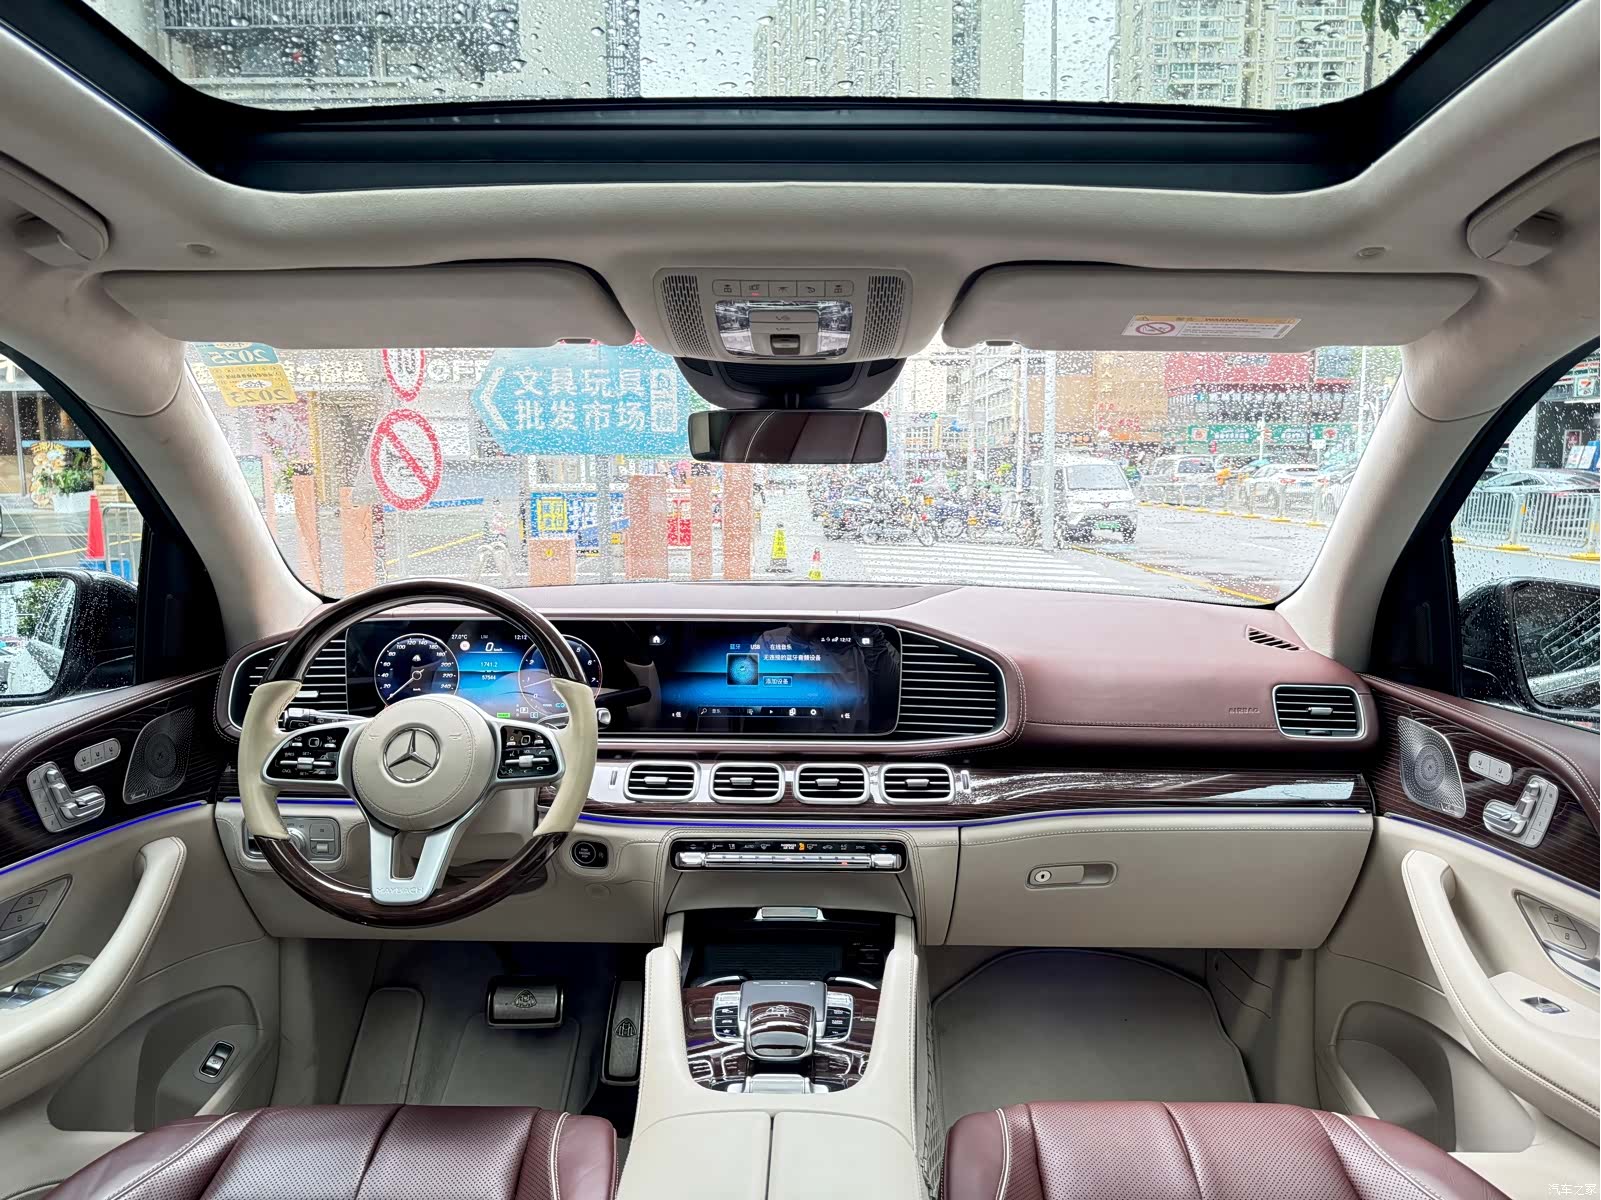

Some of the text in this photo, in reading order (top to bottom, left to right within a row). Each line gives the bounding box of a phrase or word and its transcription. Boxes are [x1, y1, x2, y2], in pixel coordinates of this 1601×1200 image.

[513, 366, 645, 397] 文具玩具
[514, 400, 646, 432] 批发市场
[485, 641, 494, 652] 0
[375, 886, 424, 896] MAYBACH
